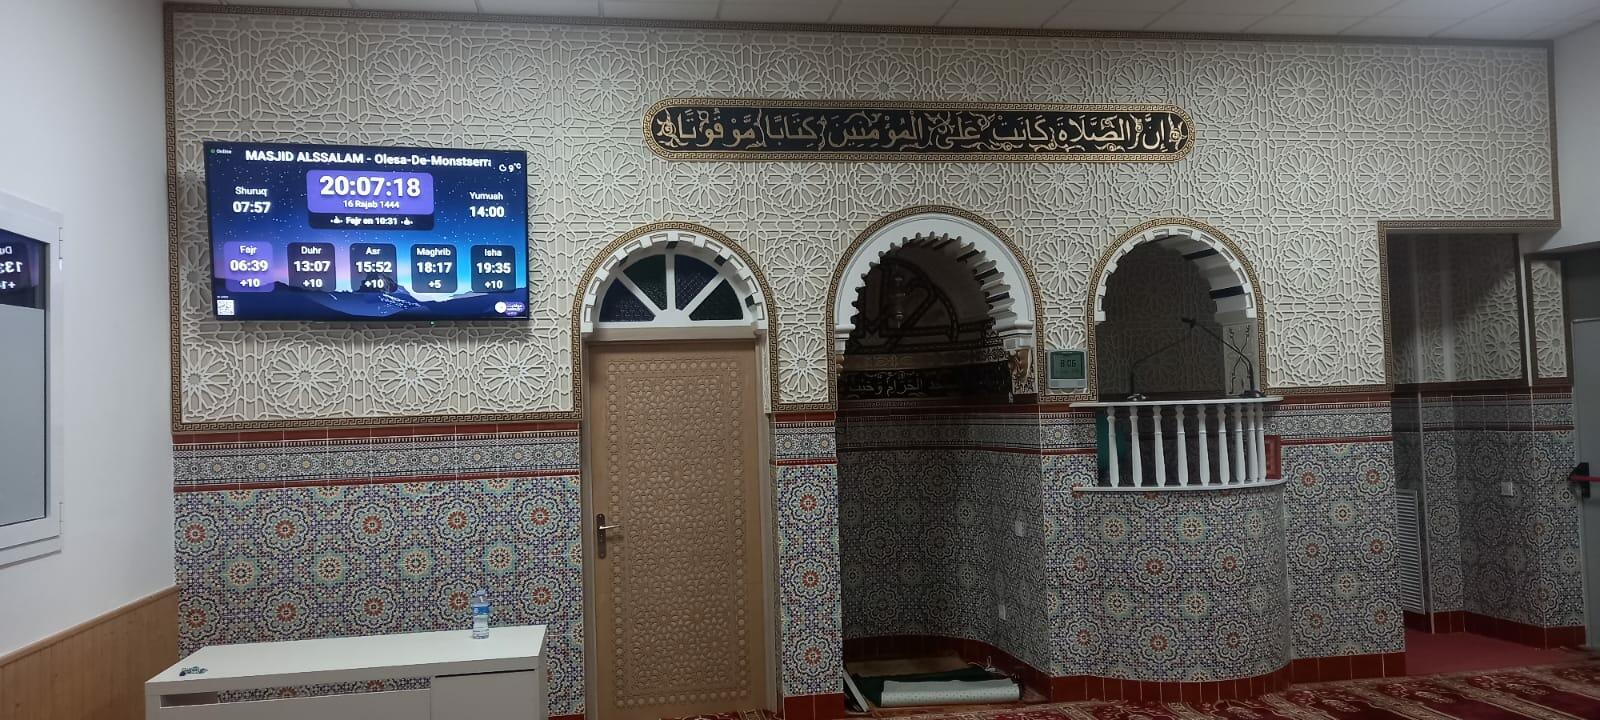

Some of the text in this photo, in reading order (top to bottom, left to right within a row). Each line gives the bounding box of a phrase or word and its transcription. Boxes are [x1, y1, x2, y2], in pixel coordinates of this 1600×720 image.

[245, 150, 294, 162] MASJID
[297, 151, 364, 164] ALSSALAM
[319, 175, 421, 197] 20:07:18
[235, 186, 268, 197] Shuruq
[469, 191, 504, 200] Yumuah
[233, 201, 272, 214] 07:57
[343, 200, 400, 209] 16 Rajab 1444
[469, 206, 505, 218] 14:00
[345, 217, 362, 226] Fajr
[375, 217, 398, 225] 10:31
[240, 245, 258, 254] Fajr
[301, 246, 322, 255] Duhr
[365, 247, 381, 255] Asr
[416, 247, 451, 257] Maghrib
[484, 248, 502, 257] Isha
[230, 259, 269, 272] 06:39
[293, 260, 331, 272] 13:07
[355, 261, 393, 273] 15:52
[416, 262, 452, 274] 18:17
[476, 262, 511, 274] 19:35
[240, 278, 261, 288] +10
[303, 279, 323, 288] +10
[364, 279, 384, 289] +10
[428, 279, 442, 289] +5
[484, 280, 503, 289] +10
